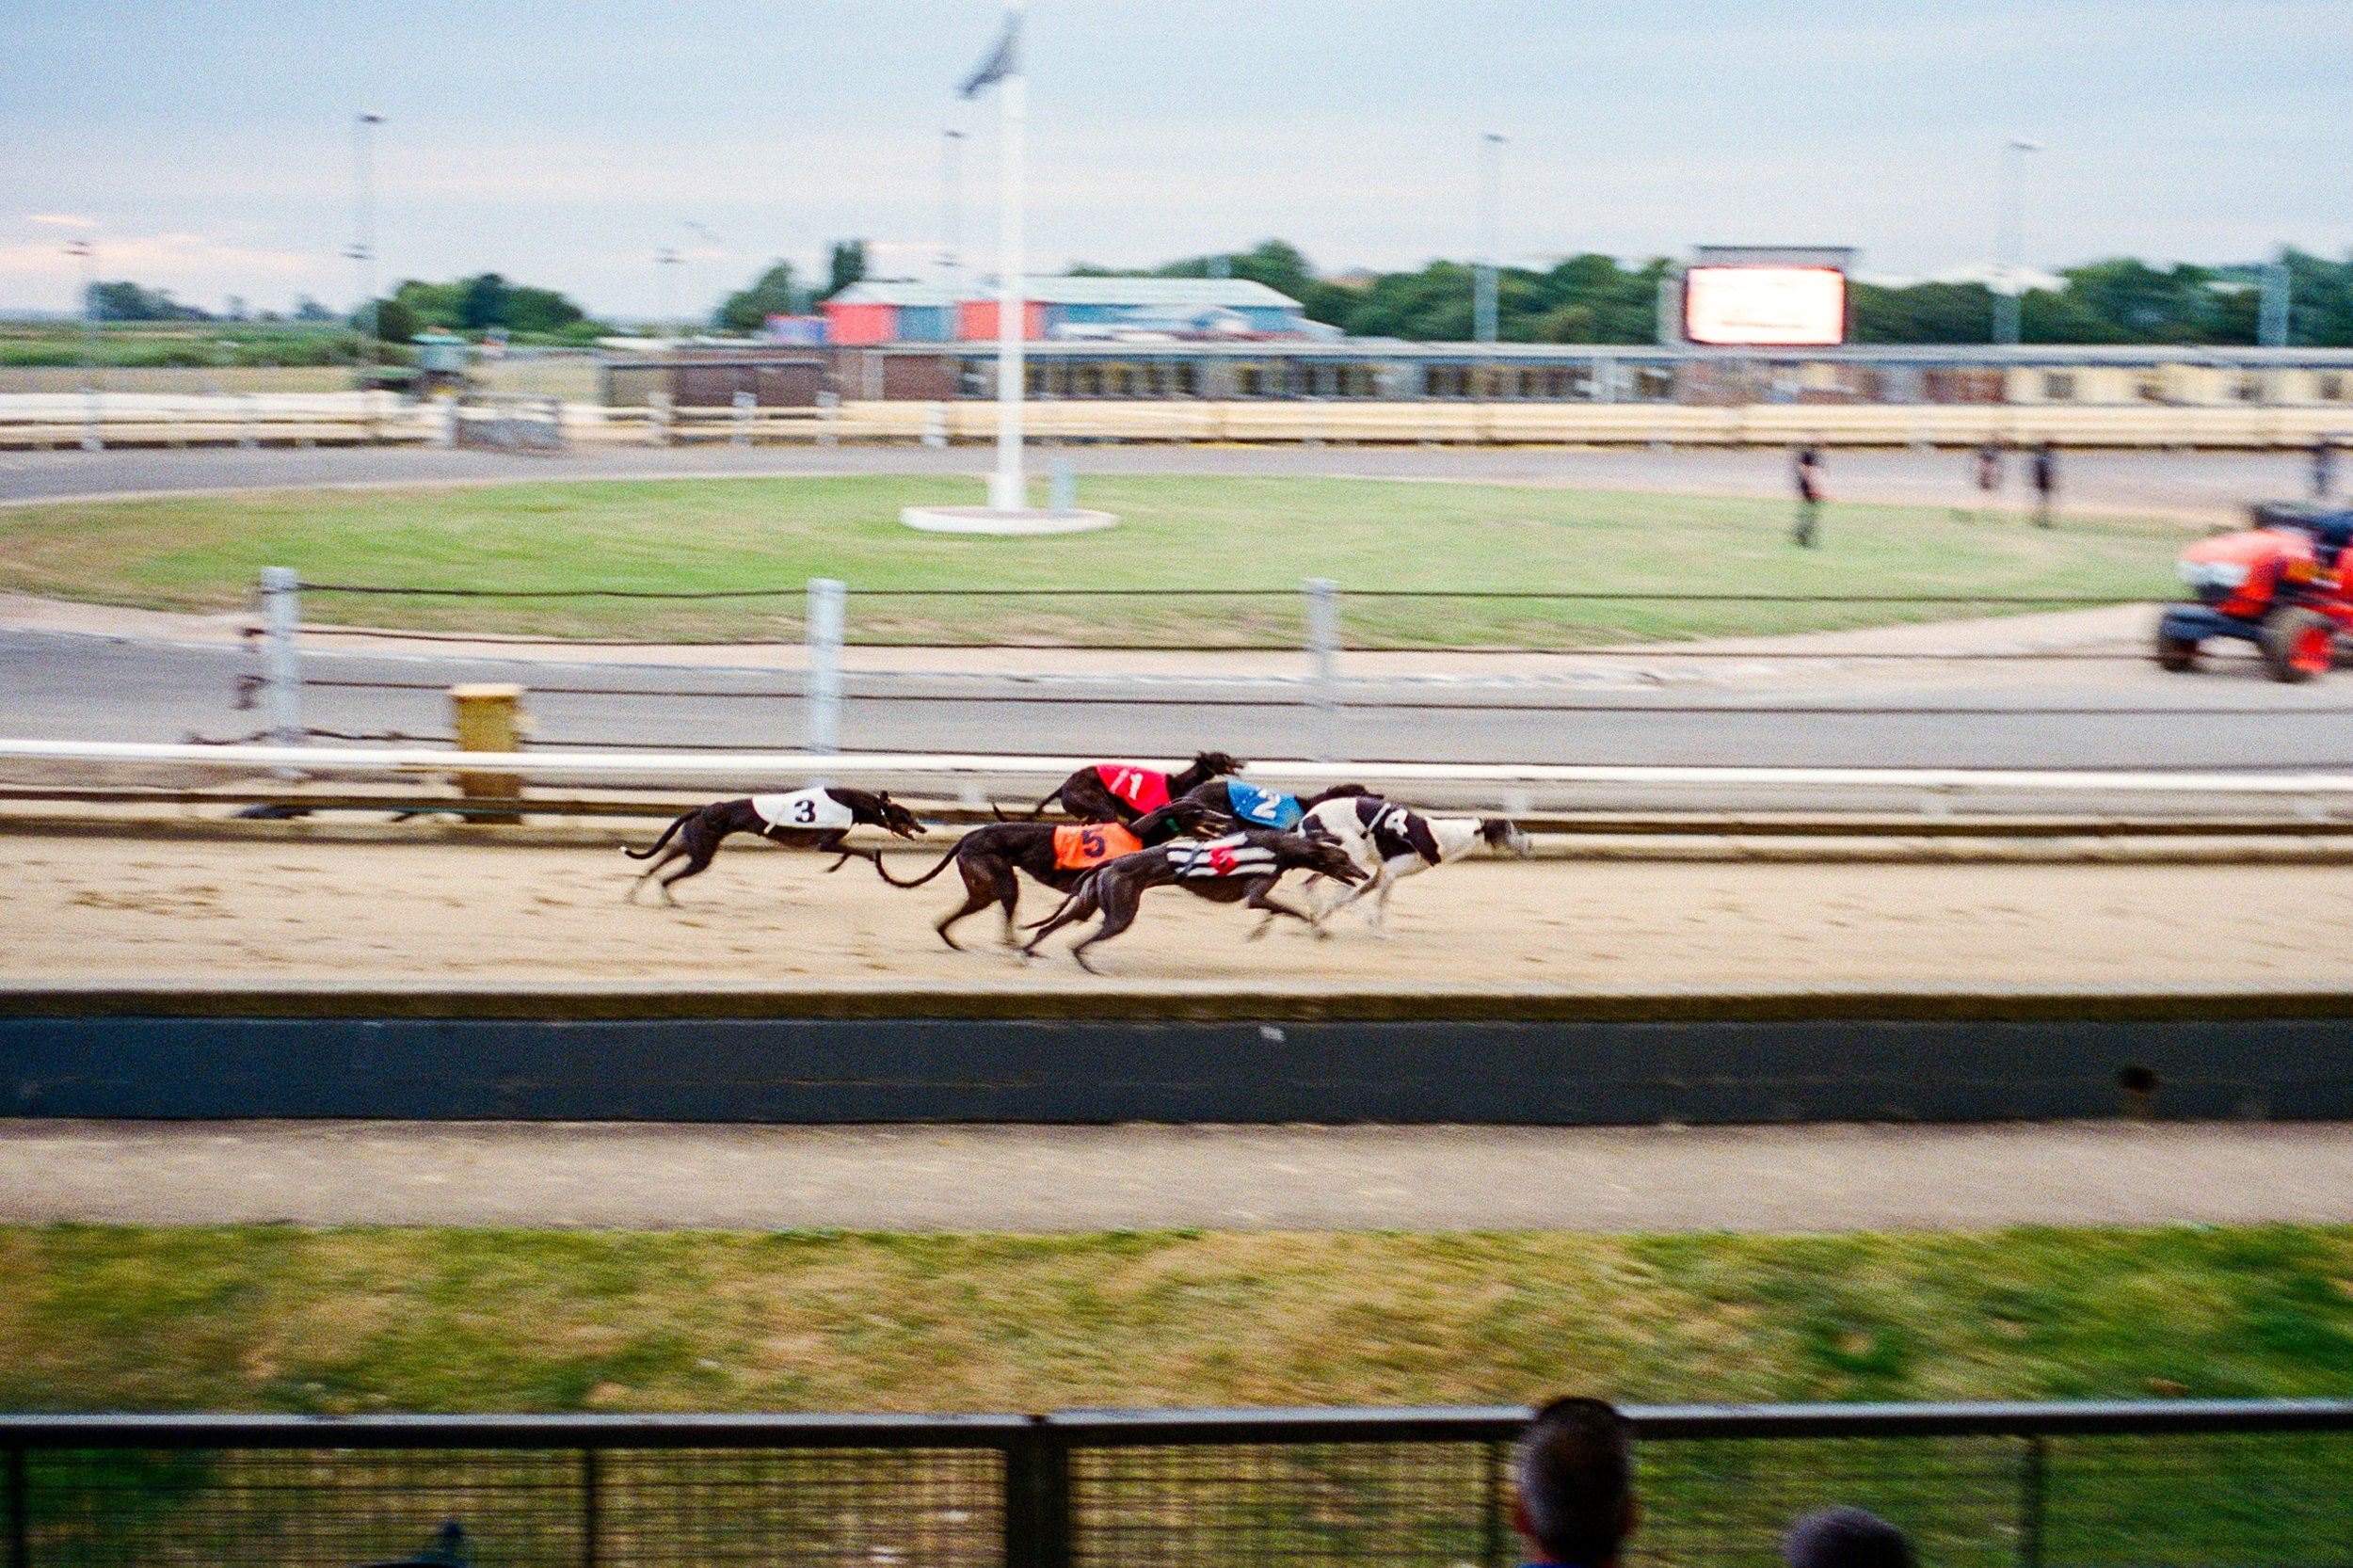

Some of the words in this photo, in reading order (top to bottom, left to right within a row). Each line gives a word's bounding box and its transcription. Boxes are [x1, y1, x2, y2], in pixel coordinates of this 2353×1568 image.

[794, 799, 816, 824] 3
[1252, 789, 1281, 820] 2
[1082, 824, 1105, 858] 5
